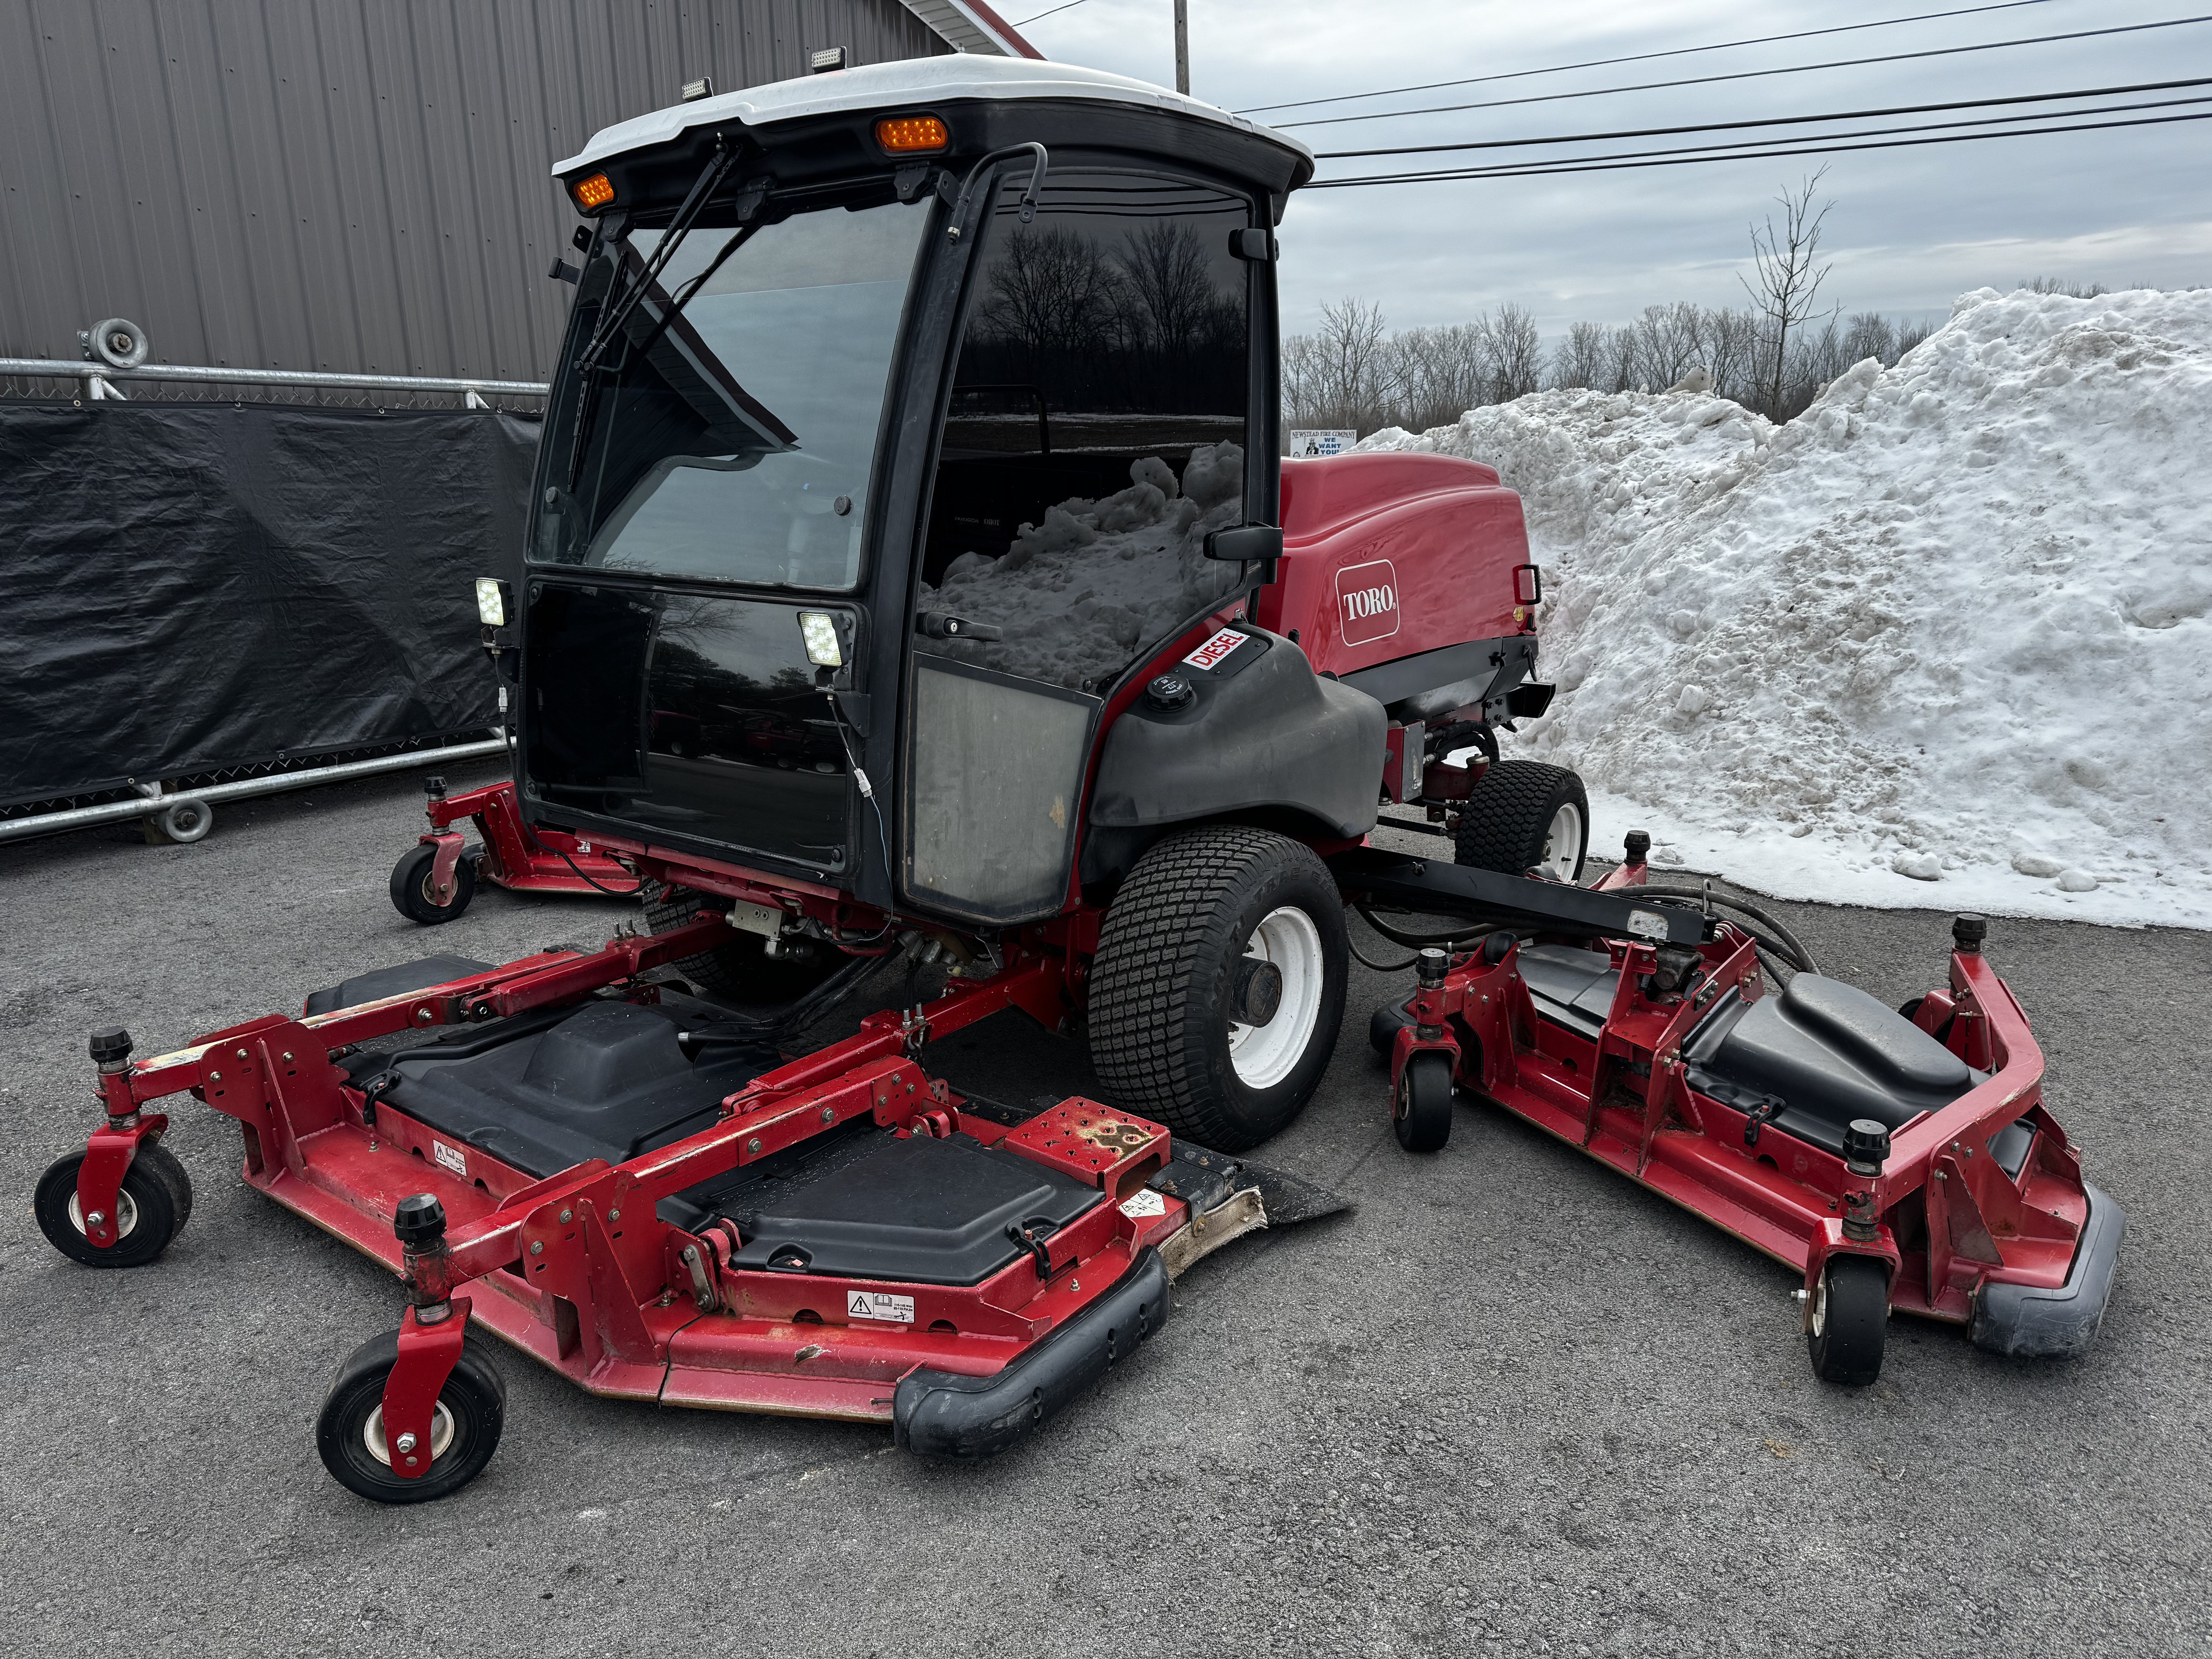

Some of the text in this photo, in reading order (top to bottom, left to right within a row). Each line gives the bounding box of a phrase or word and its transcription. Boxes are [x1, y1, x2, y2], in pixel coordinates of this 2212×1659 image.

[1292, 431, 1319, 439] NEWSTEAD
[1343, 585, 1394, 621] TORO
[1190, 633, 1244, 666] DIESEL
